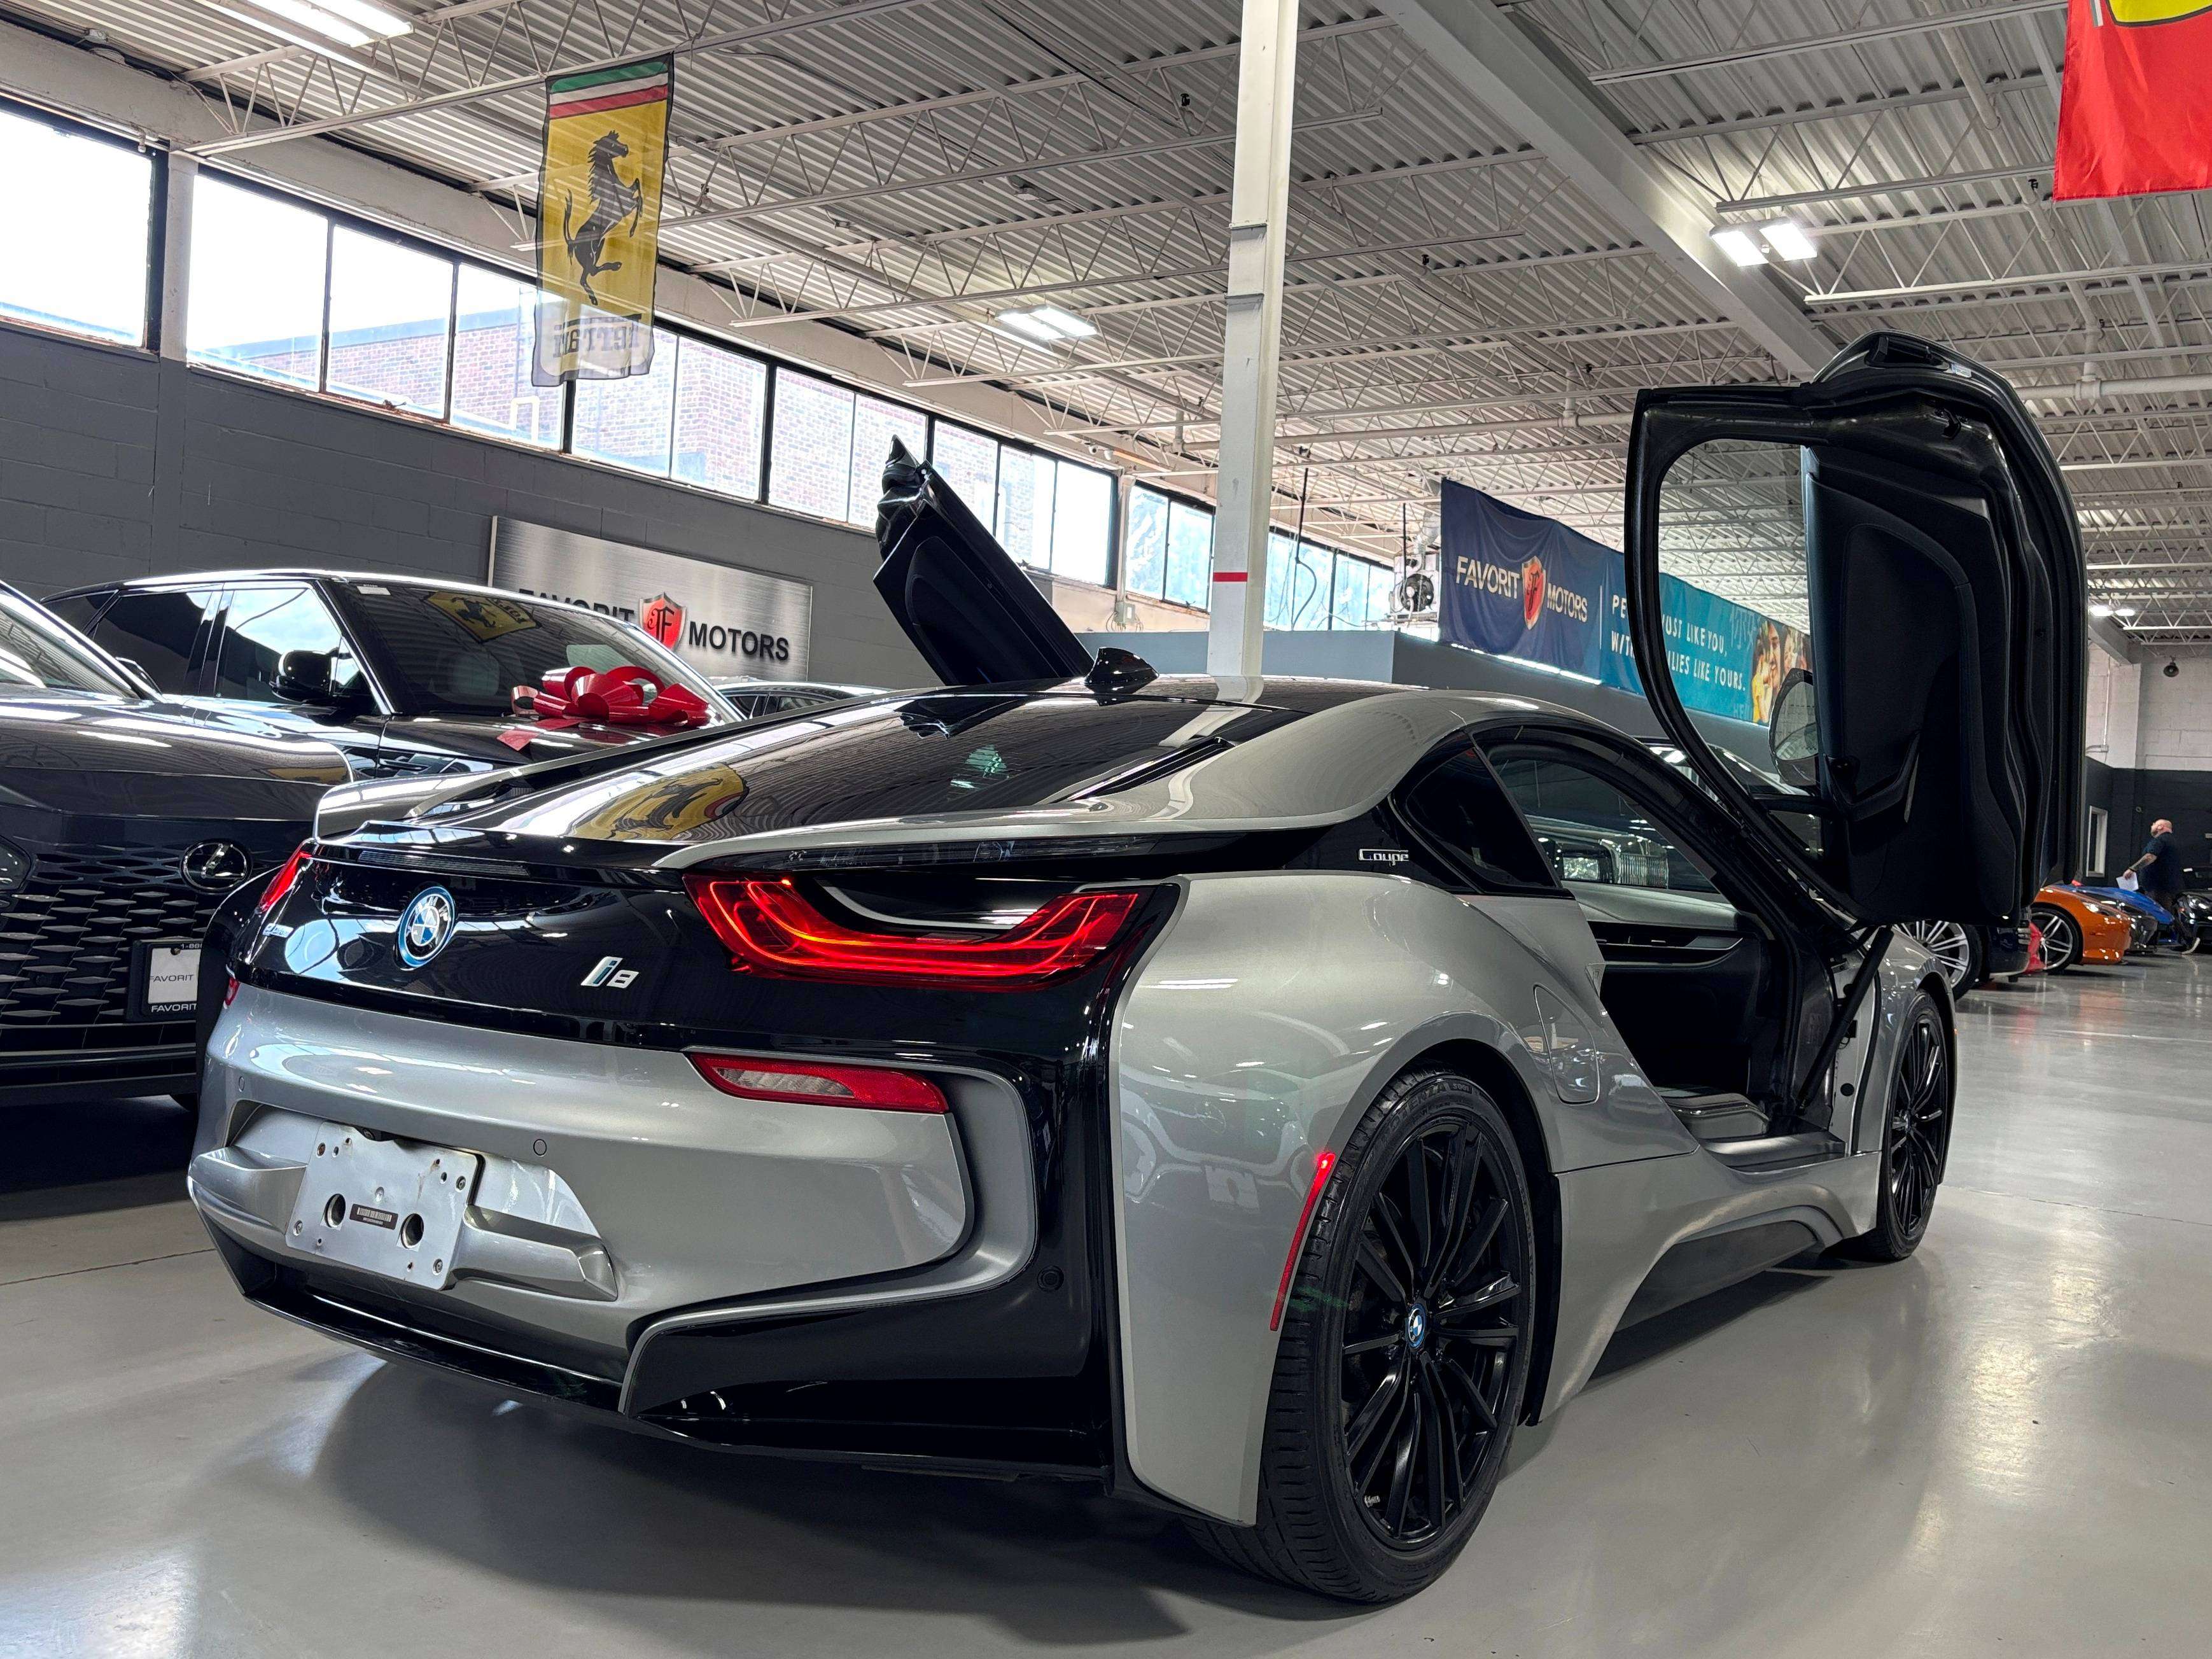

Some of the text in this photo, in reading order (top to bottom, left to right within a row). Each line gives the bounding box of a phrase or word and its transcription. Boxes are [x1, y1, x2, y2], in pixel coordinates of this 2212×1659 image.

[1456, 556, 1520, 599] FAVORIT
[1547, 583, 1588, 623] MOTORS
[689, 620, 789, 661] MOTORS
[1686, 622, 1705, 647] LIKE
[1693, 659, 1710, 682] LIKE
[1714, 666, 1746, 691] YOURS.
[1359, 848, 1409, 866] Coupe
[580, 956, 640, 988] i8
[151, 1003, 197, 1012] FAVORIT
